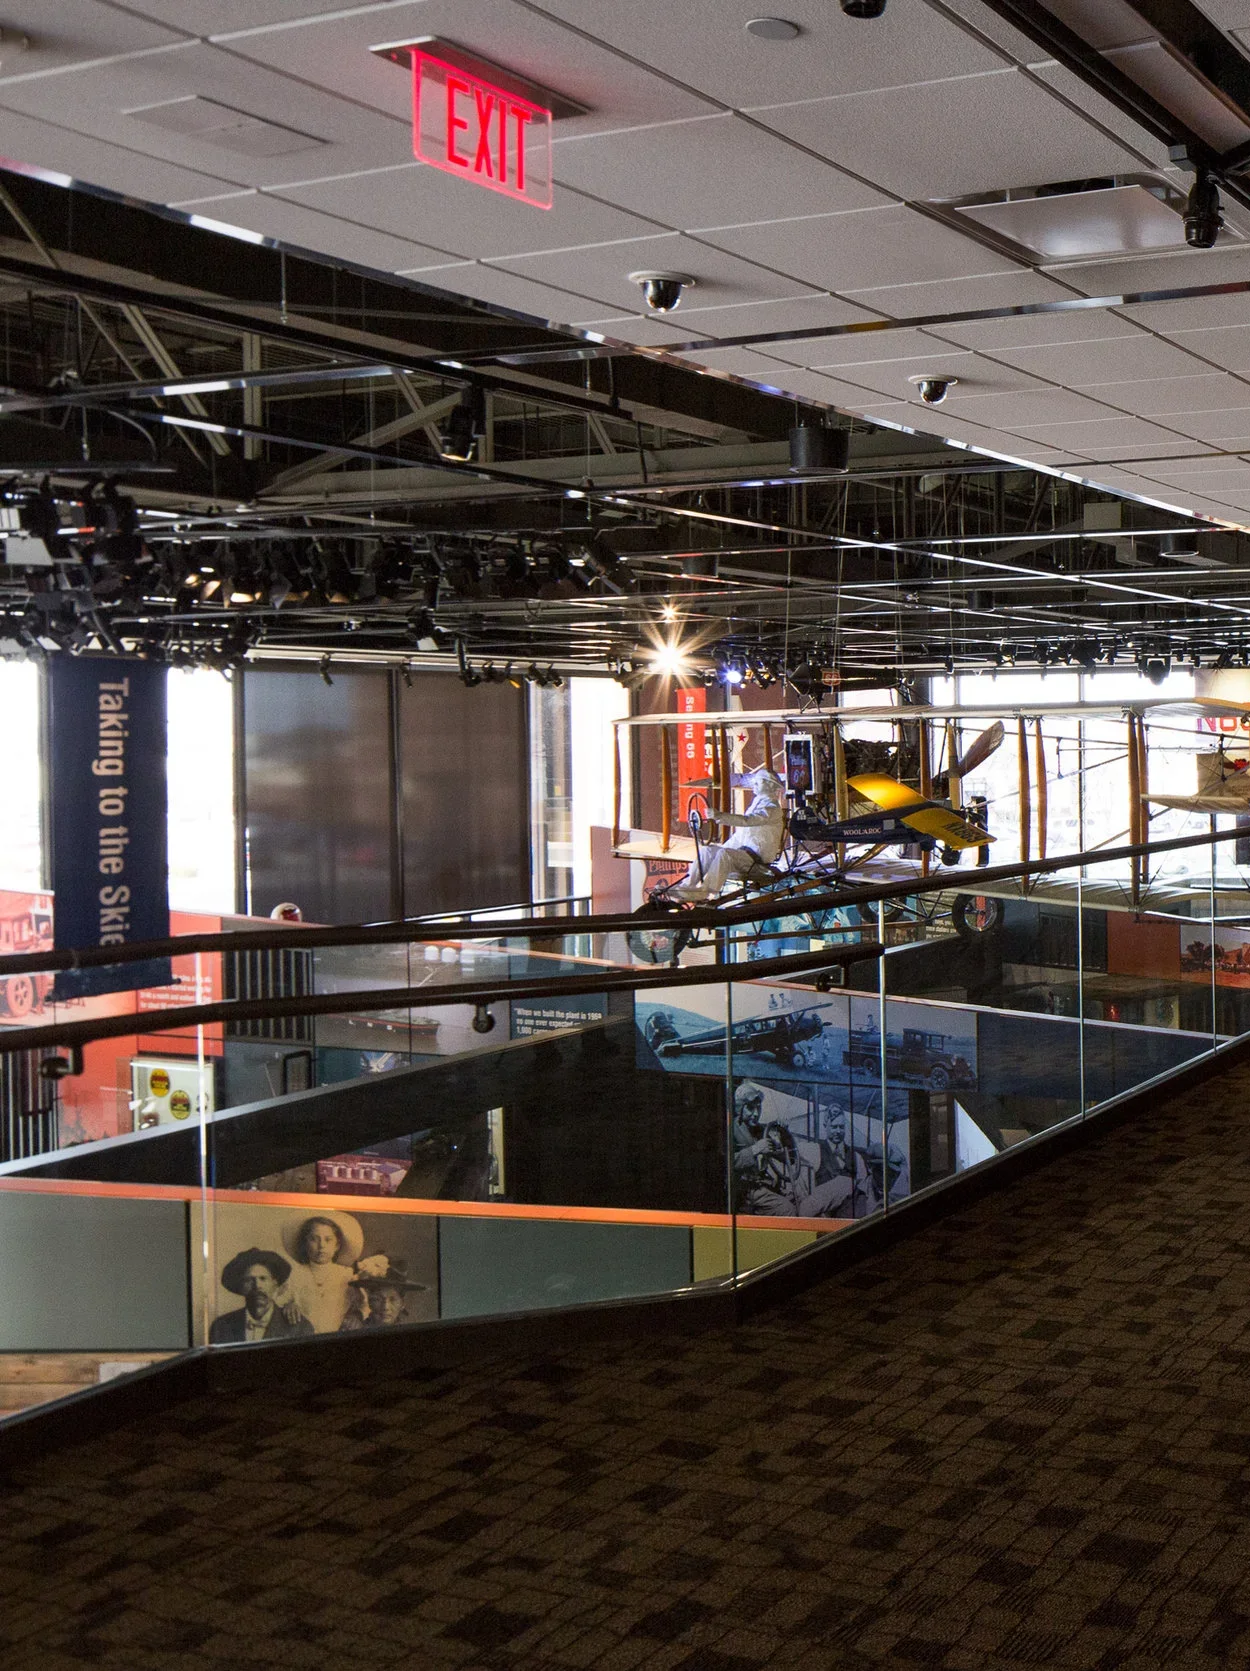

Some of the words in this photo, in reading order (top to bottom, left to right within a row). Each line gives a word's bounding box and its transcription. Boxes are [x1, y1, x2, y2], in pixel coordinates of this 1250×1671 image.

[447, 75, 531, 190] EXIT
[92, 677, 130, 776] Taking
[99, 786, 129, 816] to
[99, 825, 130, 875] the
[99, 885, 130, 947] Skie
